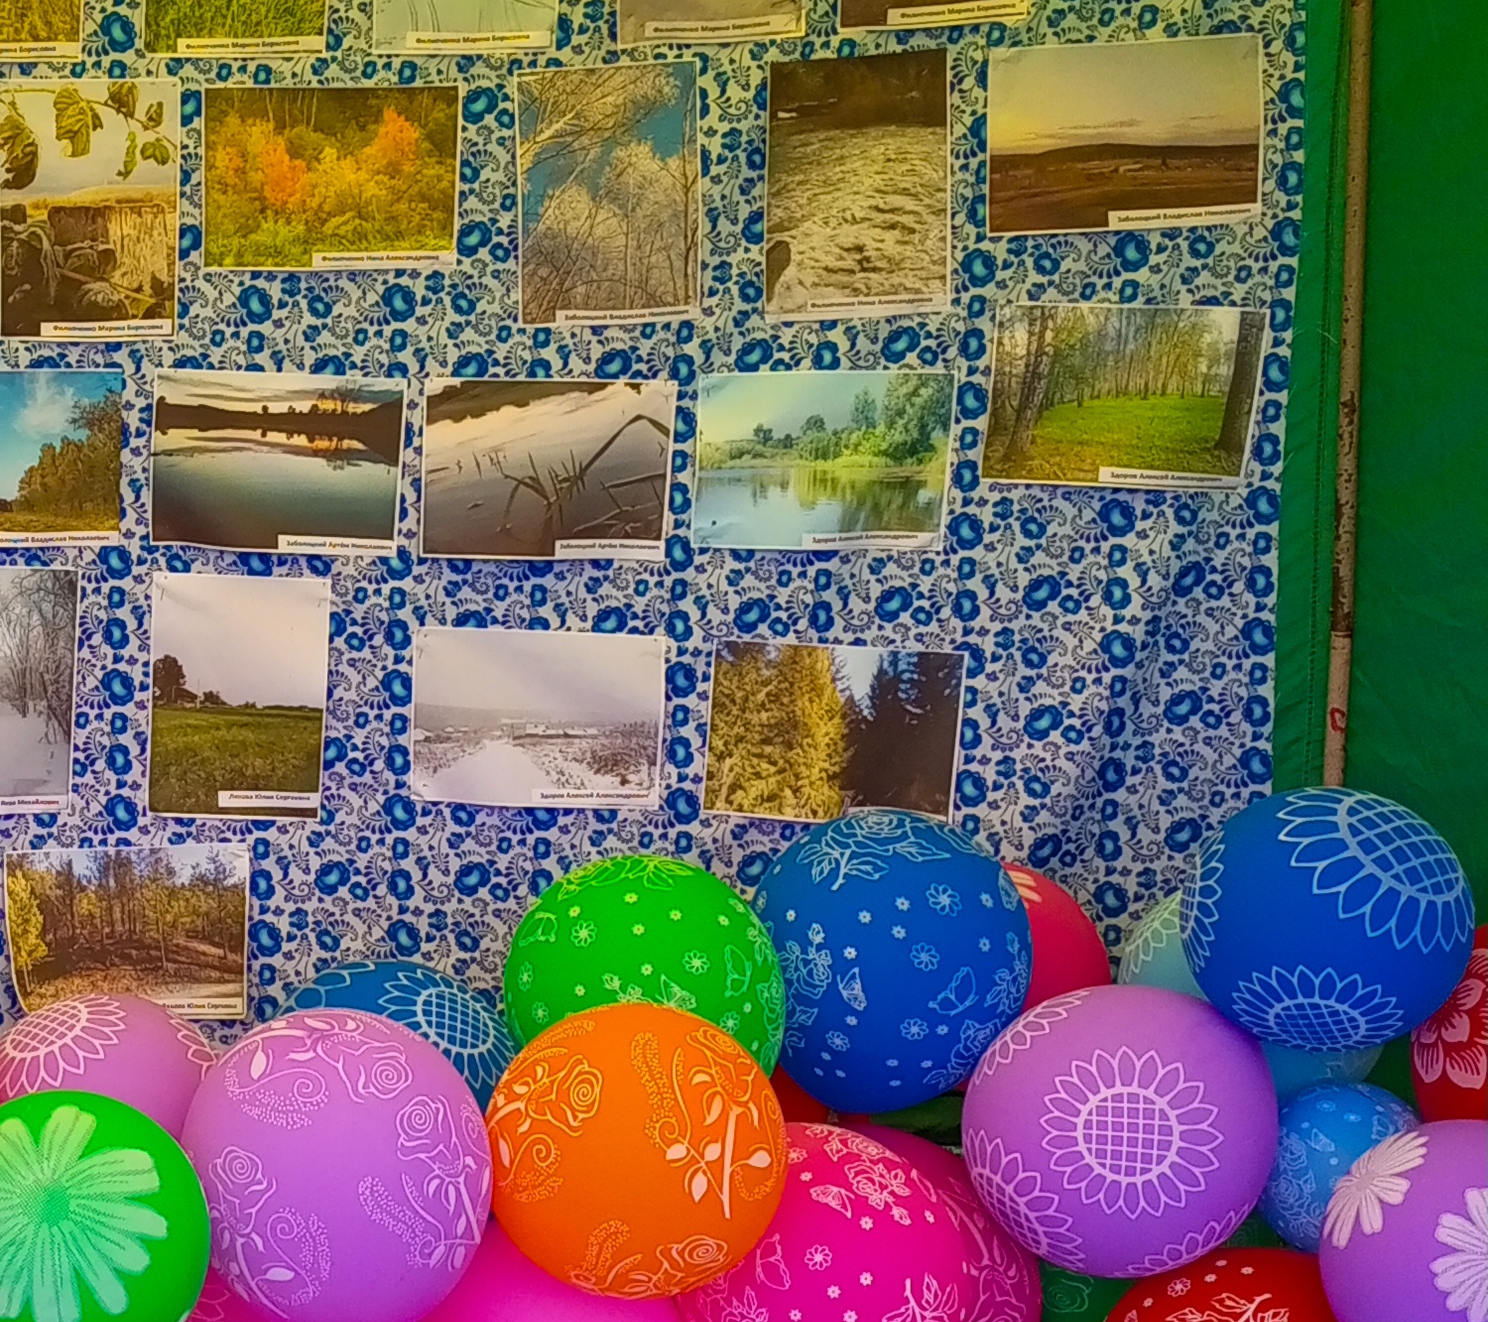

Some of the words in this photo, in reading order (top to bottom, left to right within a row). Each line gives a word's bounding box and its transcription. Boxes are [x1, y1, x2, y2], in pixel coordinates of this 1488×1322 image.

[948, 7, 975, 16] Марина
[977, 2, 1016, 13] Борисовна
[701, 24, 730, 32] Марина
[732, 20, 770, 30] Борисовна
[462, 36, 490, 44] Марина
[492, 33, 530, 42] Борисовна
[19, 45, 56, 53] Борисовна
[232, 41, 260, 49] Марина
[262, 39, 299, 48] Борисовна
[1163, 210, 1203, 220] Владислав
[1204, 208, 1251, 217] Николаевич
[386, 254, 439, 262] Александровна
[878, 296, 933, 306] Александровна
[609, 311, 646, 320] Владислав
[648, 308, 689, 317] Николаевич
[98, 324, 125, 332] Марина
[127, 323, 163, 331] Борисовна
[1140, 472, 1168, 480] Алексей
[1170, 474, 1222, 482] Александрович
[839, 534, 863, 542] Алексей
[865, 534, 918, 542] Александрович
[352, 542, 392, 551] Николаевич
[595, 791, 649, 800] Александрович
[18, 798, 59, 806] Михайлович
